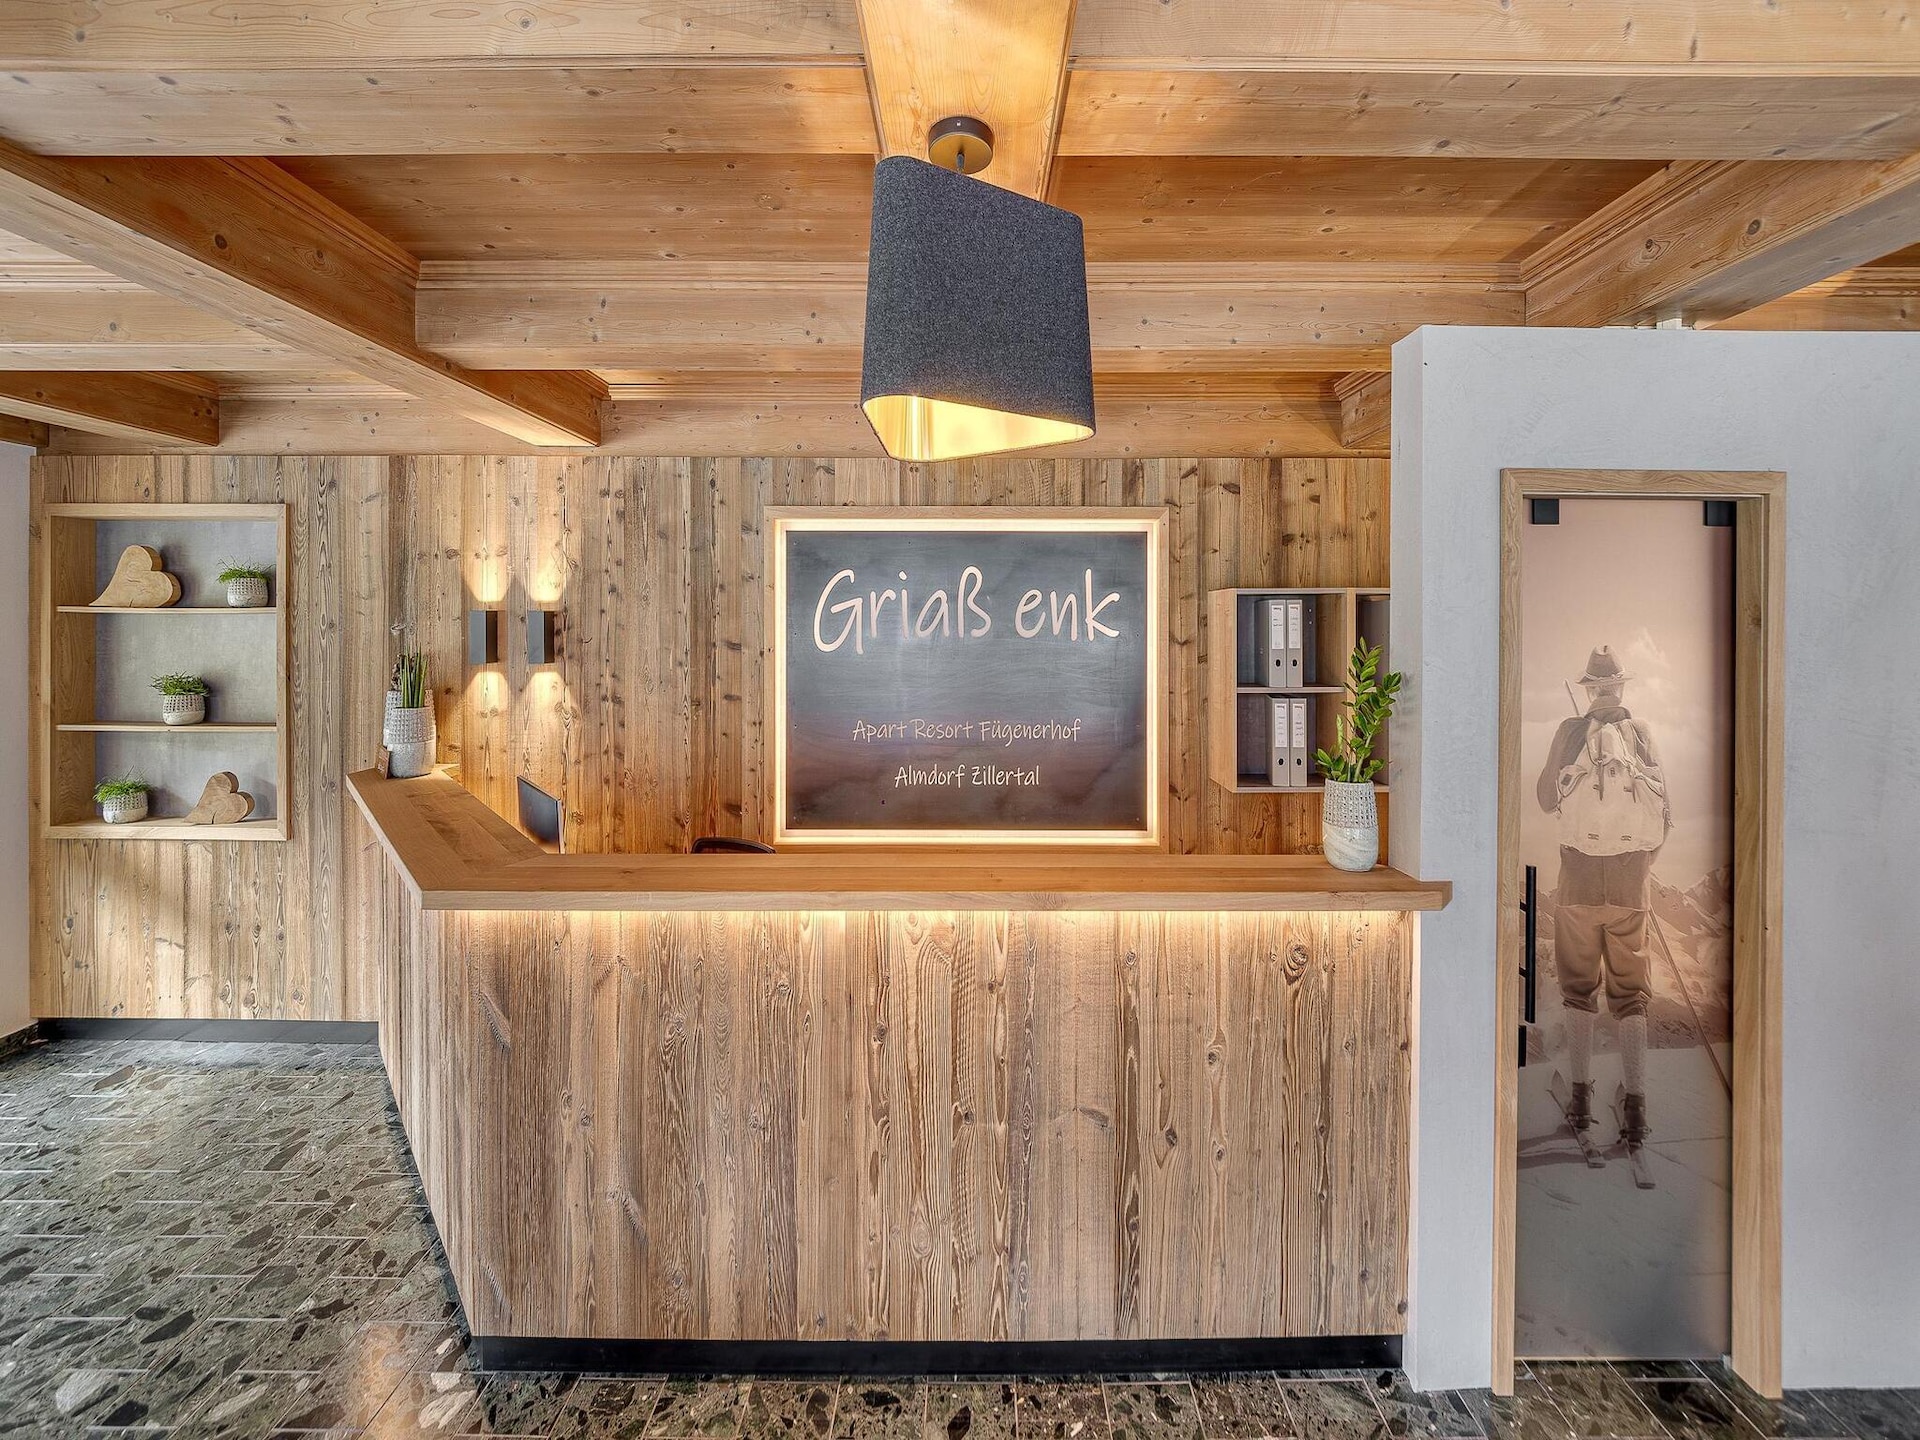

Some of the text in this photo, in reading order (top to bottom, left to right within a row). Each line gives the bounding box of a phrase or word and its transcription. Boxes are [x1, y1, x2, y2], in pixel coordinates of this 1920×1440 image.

[813, 565, 1121, 655] Griaß enk
[852, 718, 1082, 747] Apart Resort Fügenerhof
[894, 763, 1040, 788] Almdorf Zillertal
